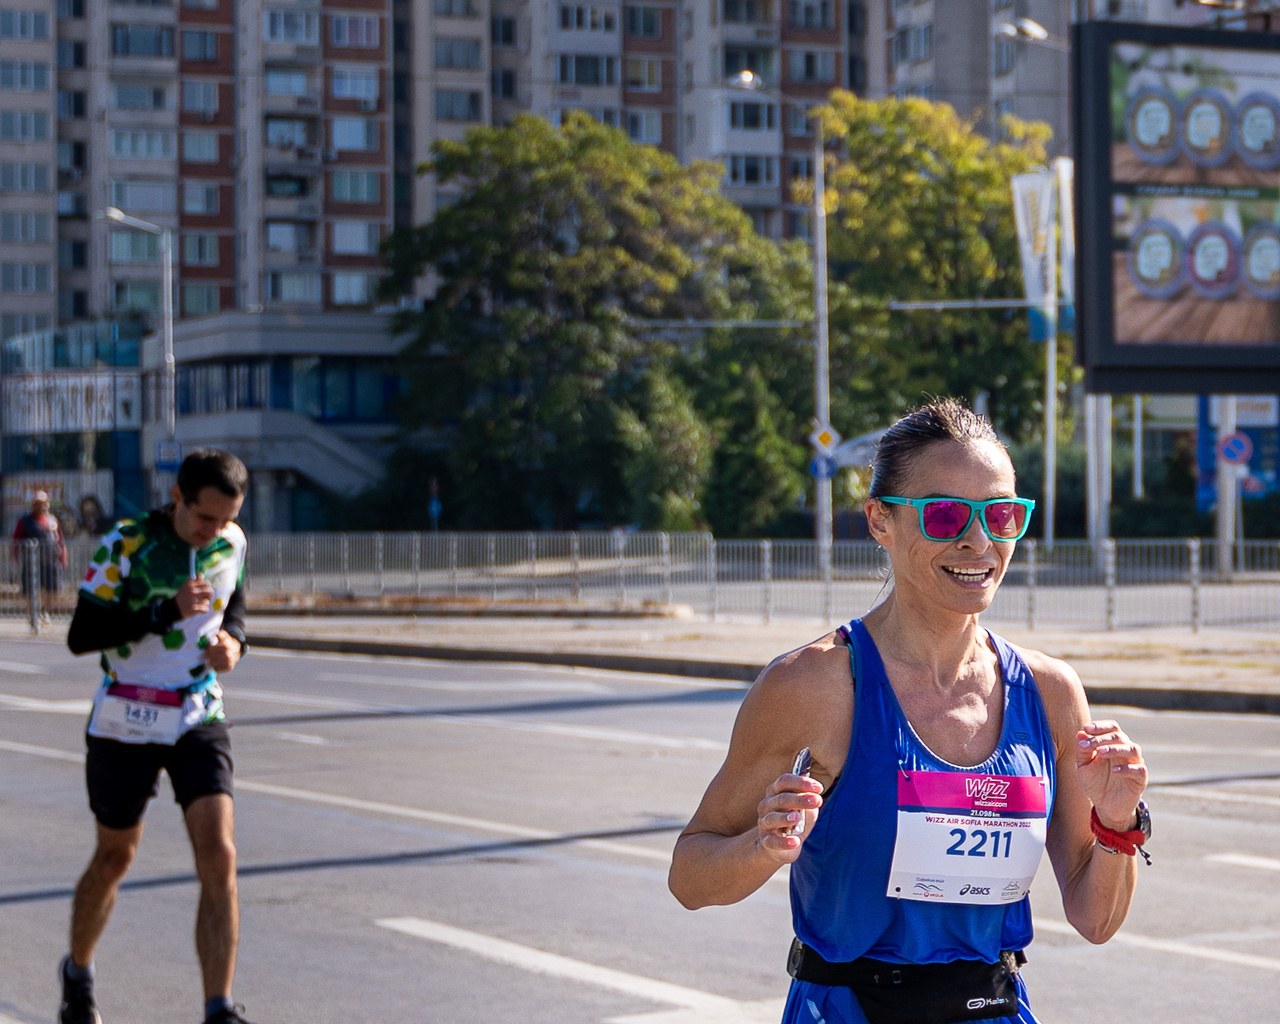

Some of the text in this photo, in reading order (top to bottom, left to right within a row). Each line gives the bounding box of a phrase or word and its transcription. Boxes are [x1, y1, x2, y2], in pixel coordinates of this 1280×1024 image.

[925, 816, 945, 824] WIZZ
[960, 818, 982, 826] SOFIA
[983, 820, 1018, 828] MARATHON
[946, 828, 1013, 858] 2211
